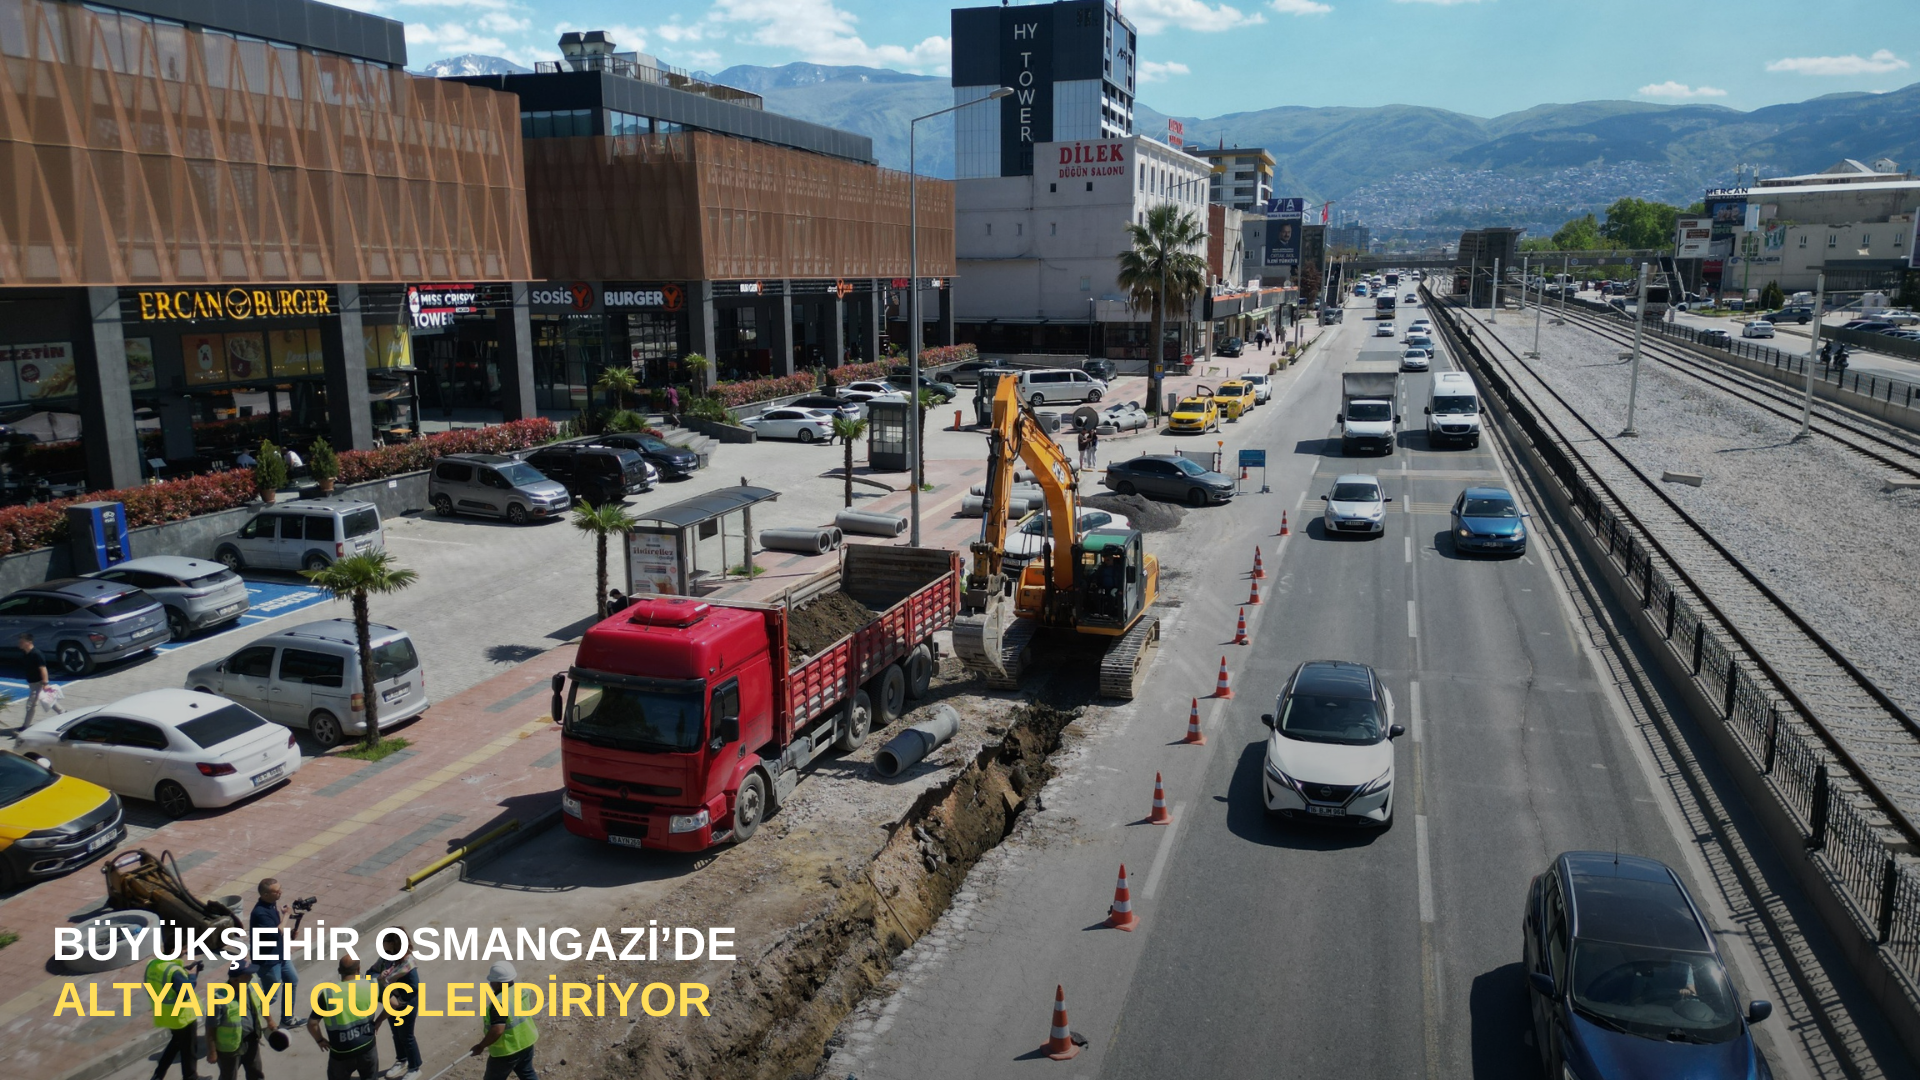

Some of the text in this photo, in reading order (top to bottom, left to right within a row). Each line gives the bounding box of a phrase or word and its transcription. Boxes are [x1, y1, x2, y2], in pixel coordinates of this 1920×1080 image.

[1014, 22, 1038, 40] HY
[1017, 52, 1035, 142] TOWER
[1059, 142, 1124, 165] DİLEK
[1059, 165, 1125, 178] DÜĞÜN SALONU
[138, 289, 331, 320] ERCAN BURGER
[420, 292, 476, 307] MISS CRISPY
[412, 311, 455, 328] TOWER
